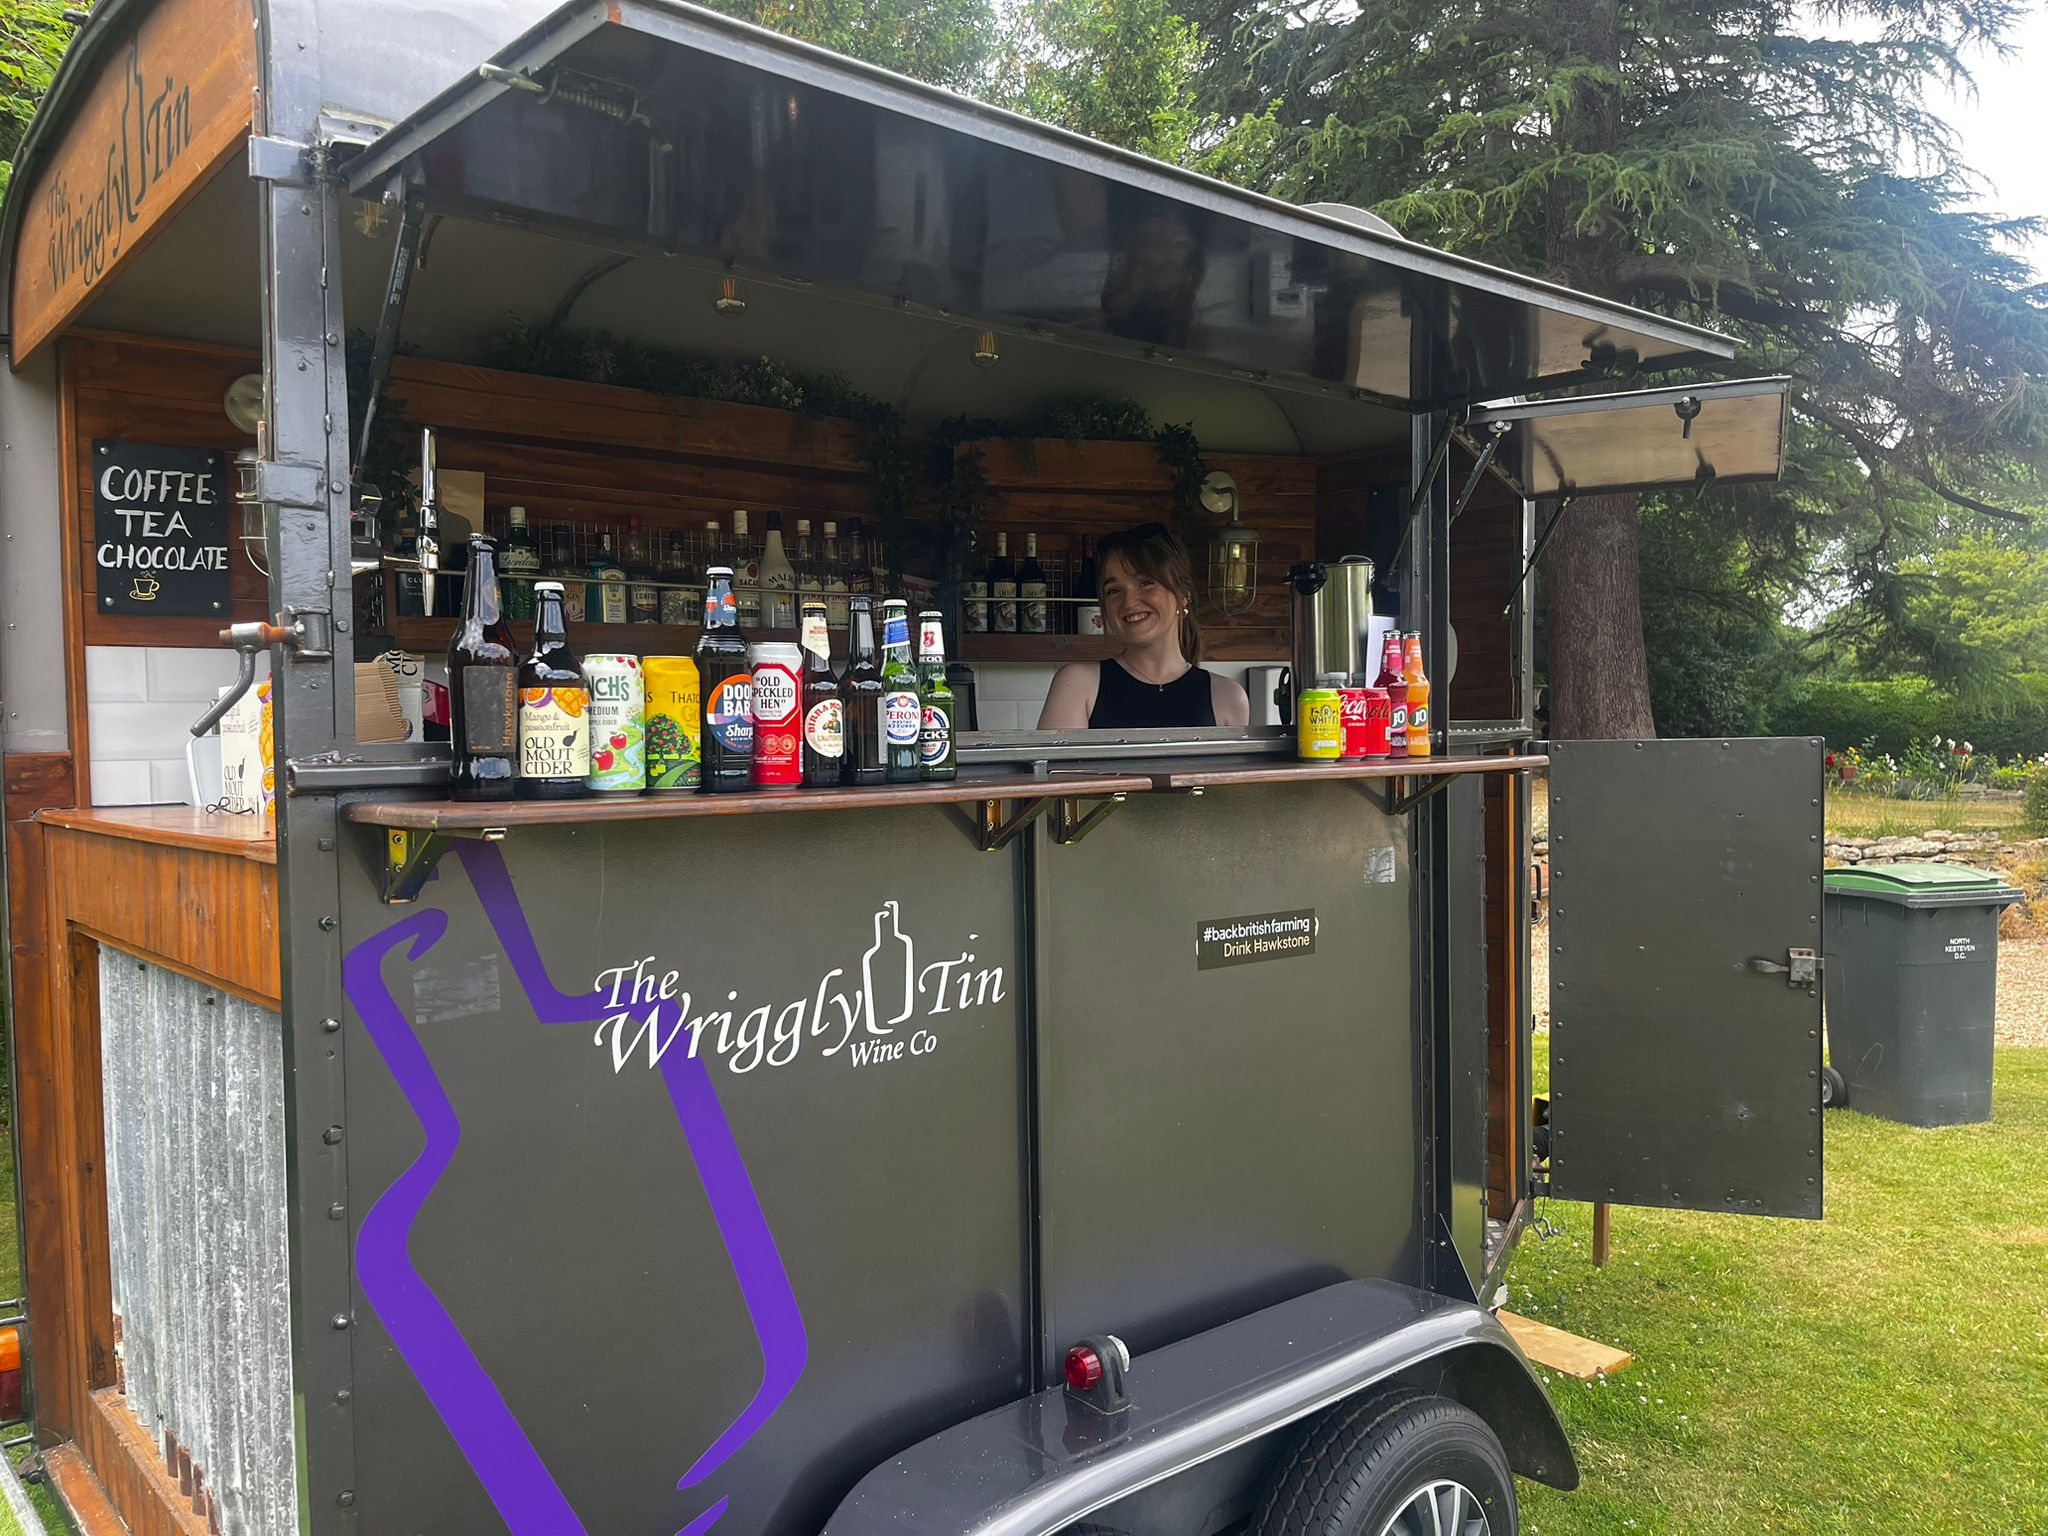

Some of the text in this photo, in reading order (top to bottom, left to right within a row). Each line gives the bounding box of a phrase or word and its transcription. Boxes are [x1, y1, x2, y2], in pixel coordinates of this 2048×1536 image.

[47, 167, 67, 228] The
[49, 76, 193, 293] Wriggly Tin
[99, 465, 216, 505] COFFEE
[114, 509, 193, 538] TEA
[97, 542, 228, 571] CHOCOLATE
[588, 675, 630, 702] NCH'S
[723, 684, 753, 701] DOO
[502, 671, 514, 747] Hawkstone
[525, 712, 552, 723] Mango
[723, 700, 751, 716] BAR
[524, 722, 571, 734] passionfruit
[919, 729, 950, 740] ECK'S
[524, 736, 555, 749] OLD
[525, 748, 575, 762] MOUT
[525, 761, 574, 775] CIDER
[1203, 915, 1311, 943] #backbritishfarming
[1949, 937, 1971, 945] NORTH
[1223, 934, 1311, 958] Drink Hawkstone
[593, 955, 680, 1010] The
[593, 951, 1007, 1075] Wriggly Tin
[850, 1029, 938, 1068] Wine Co
